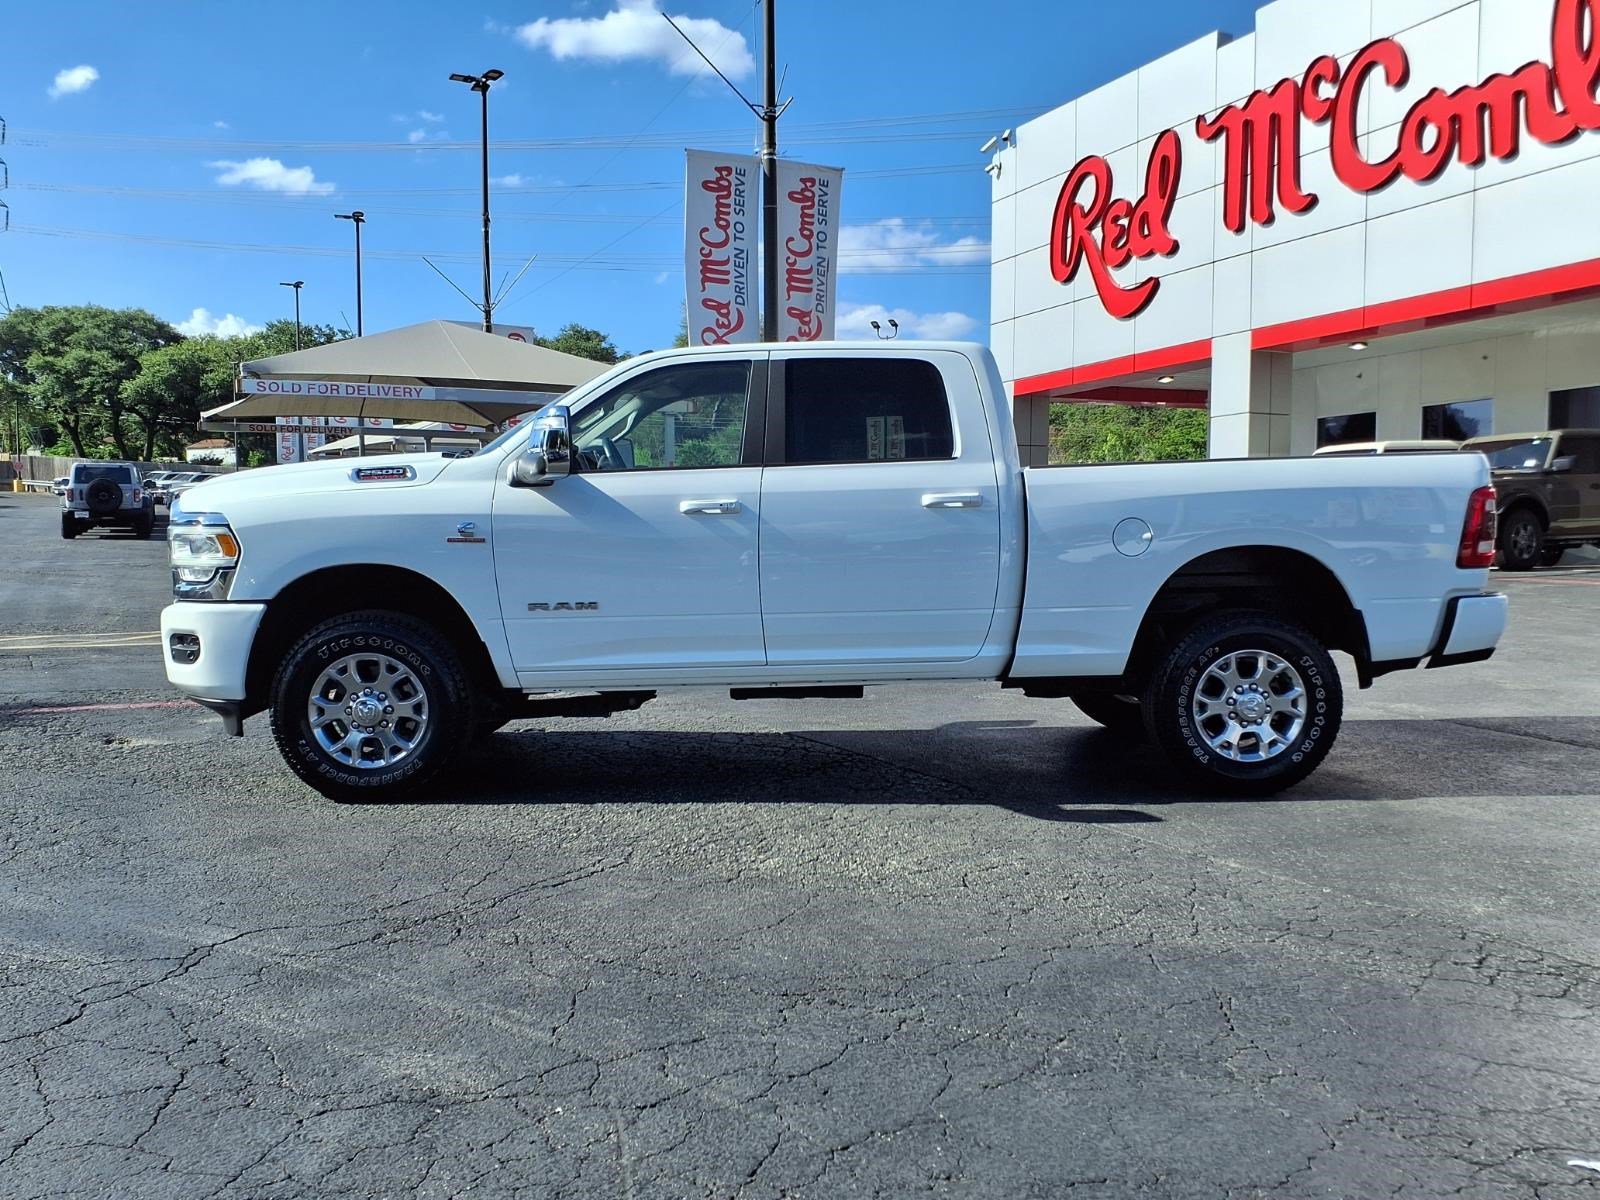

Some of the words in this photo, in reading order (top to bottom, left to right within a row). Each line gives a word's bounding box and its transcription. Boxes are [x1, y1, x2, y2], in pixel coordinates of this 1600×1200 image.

[733, 166, 747, 217] SERVE
[817, 178, 830, 226] SERVE
[699, 165, 733, 293] McCombs
[733, 221, 746, 242] TO
[785, 177, 817, 301] McCombs
[816, 231, 828, 251] TO
[1050, 128, 1181, 318] Red
[733, 247, 747, 307] DRIVEN
[815, 256, 827, 315] DRIVEN
[701, 297, 744, 346] Red
[256, 381, 302, 394] SOLD
[307, 383, 340, 396] FOR
[345, 384, 423, 399] DELIVERY
[248, 424, 278, 433] SOLD
[280, 425, 301, 434] FOR
[304, 426, 354, 435] DELIVERY
[360, 468, 404, 476] 2500
[527, 602, 599, 612] RAM
[318, 636, 432, 677] Firestone
[1291, 655, 1327, 763] Firestone
